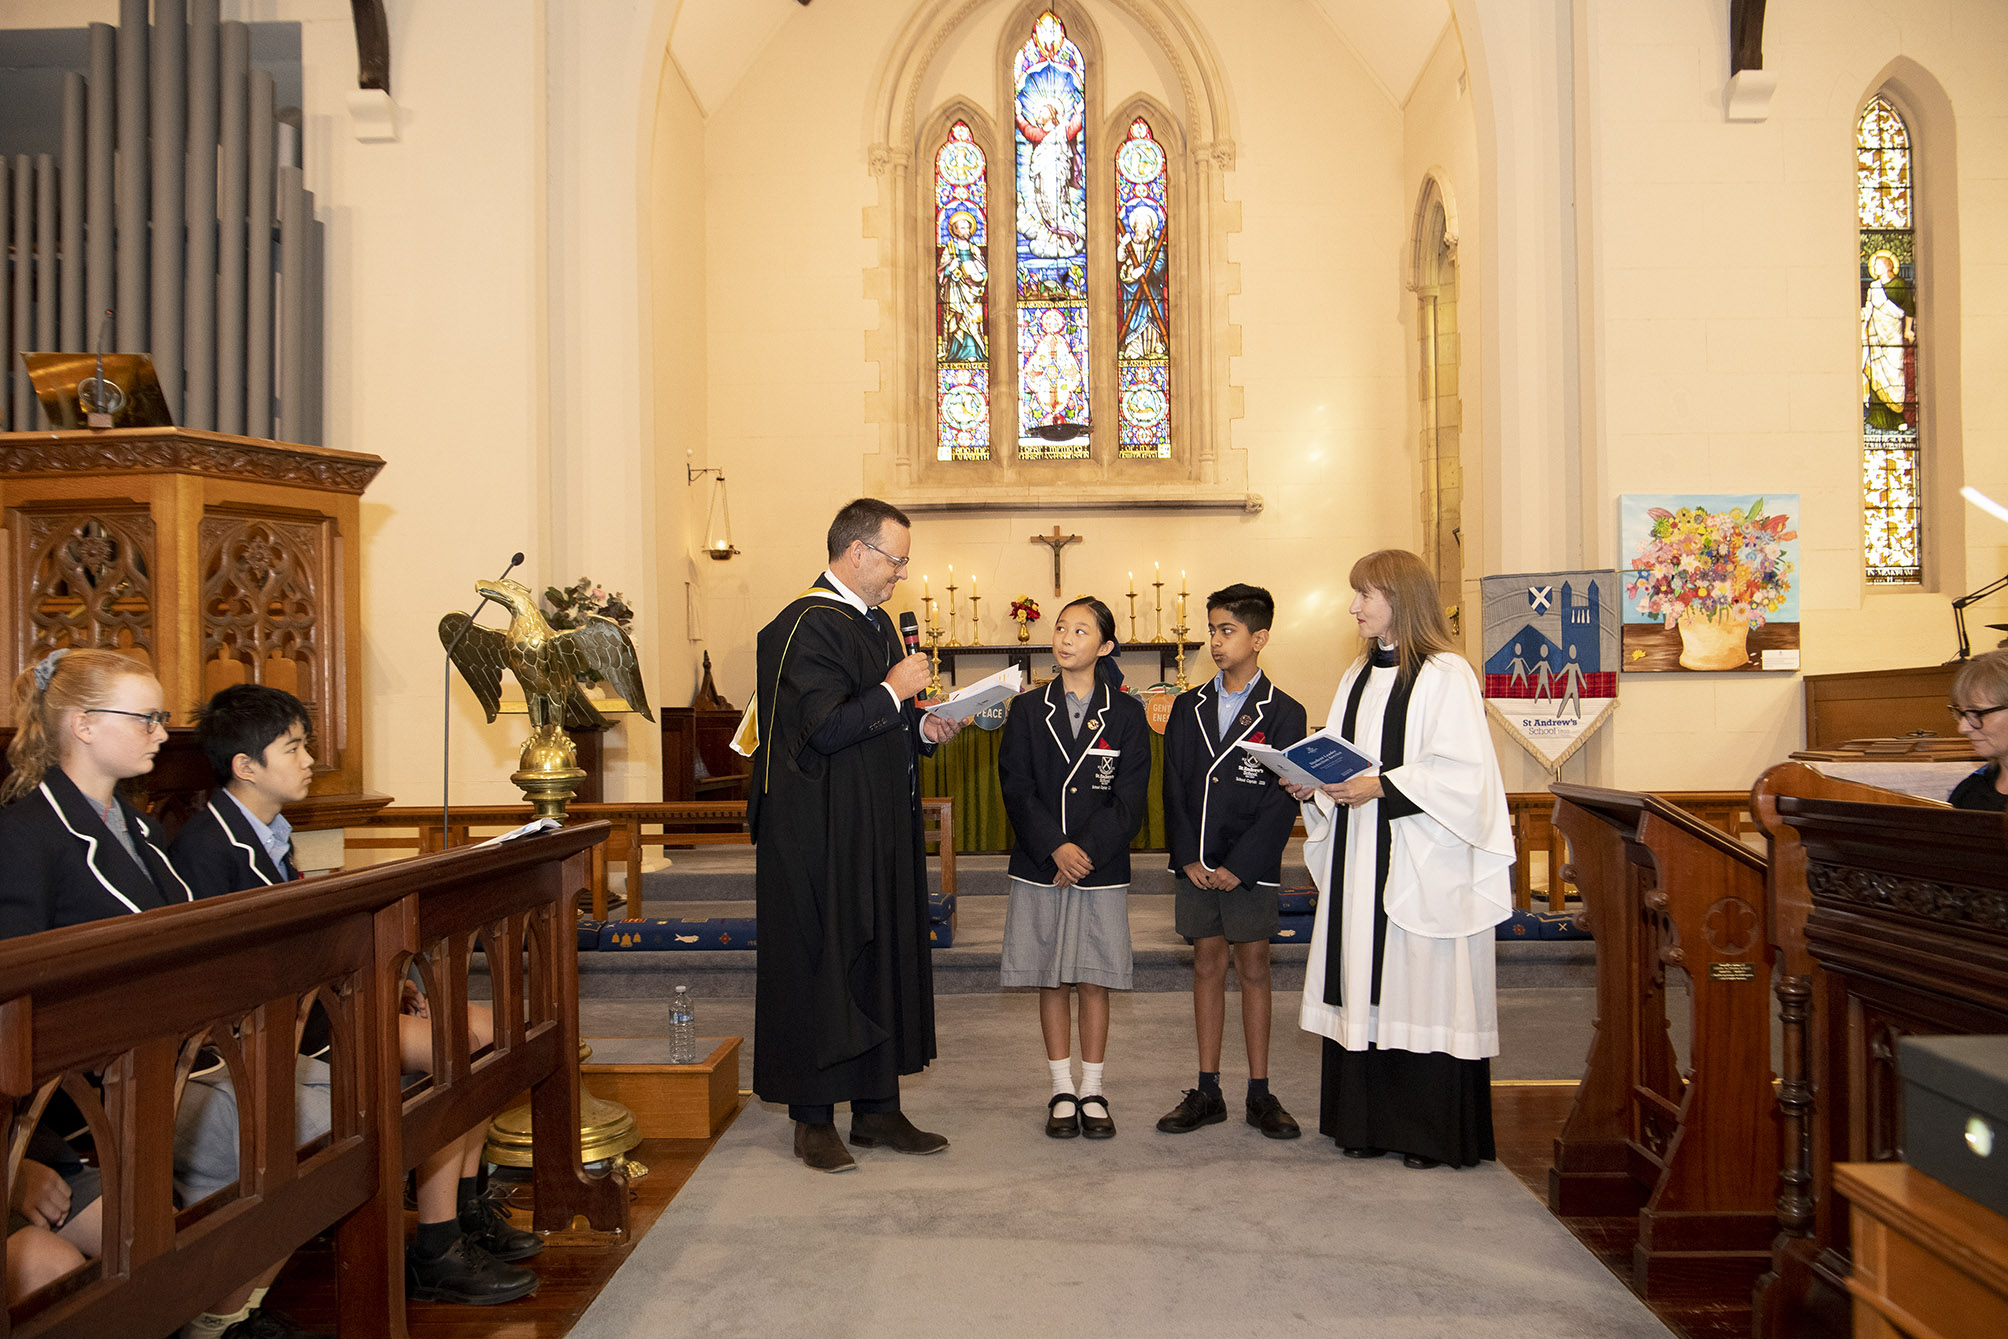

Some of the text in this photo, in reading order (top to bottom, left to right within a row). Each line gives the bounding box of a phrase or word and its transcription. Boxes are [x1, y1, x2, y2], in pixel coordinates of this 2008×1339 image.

[1153, 703, 1170, 712] GENT
[1153, 712, 1170, 722] ENES
[1522, 718, 1578, 727] St Andrew's
[1528, 727, 1556, 735] School
